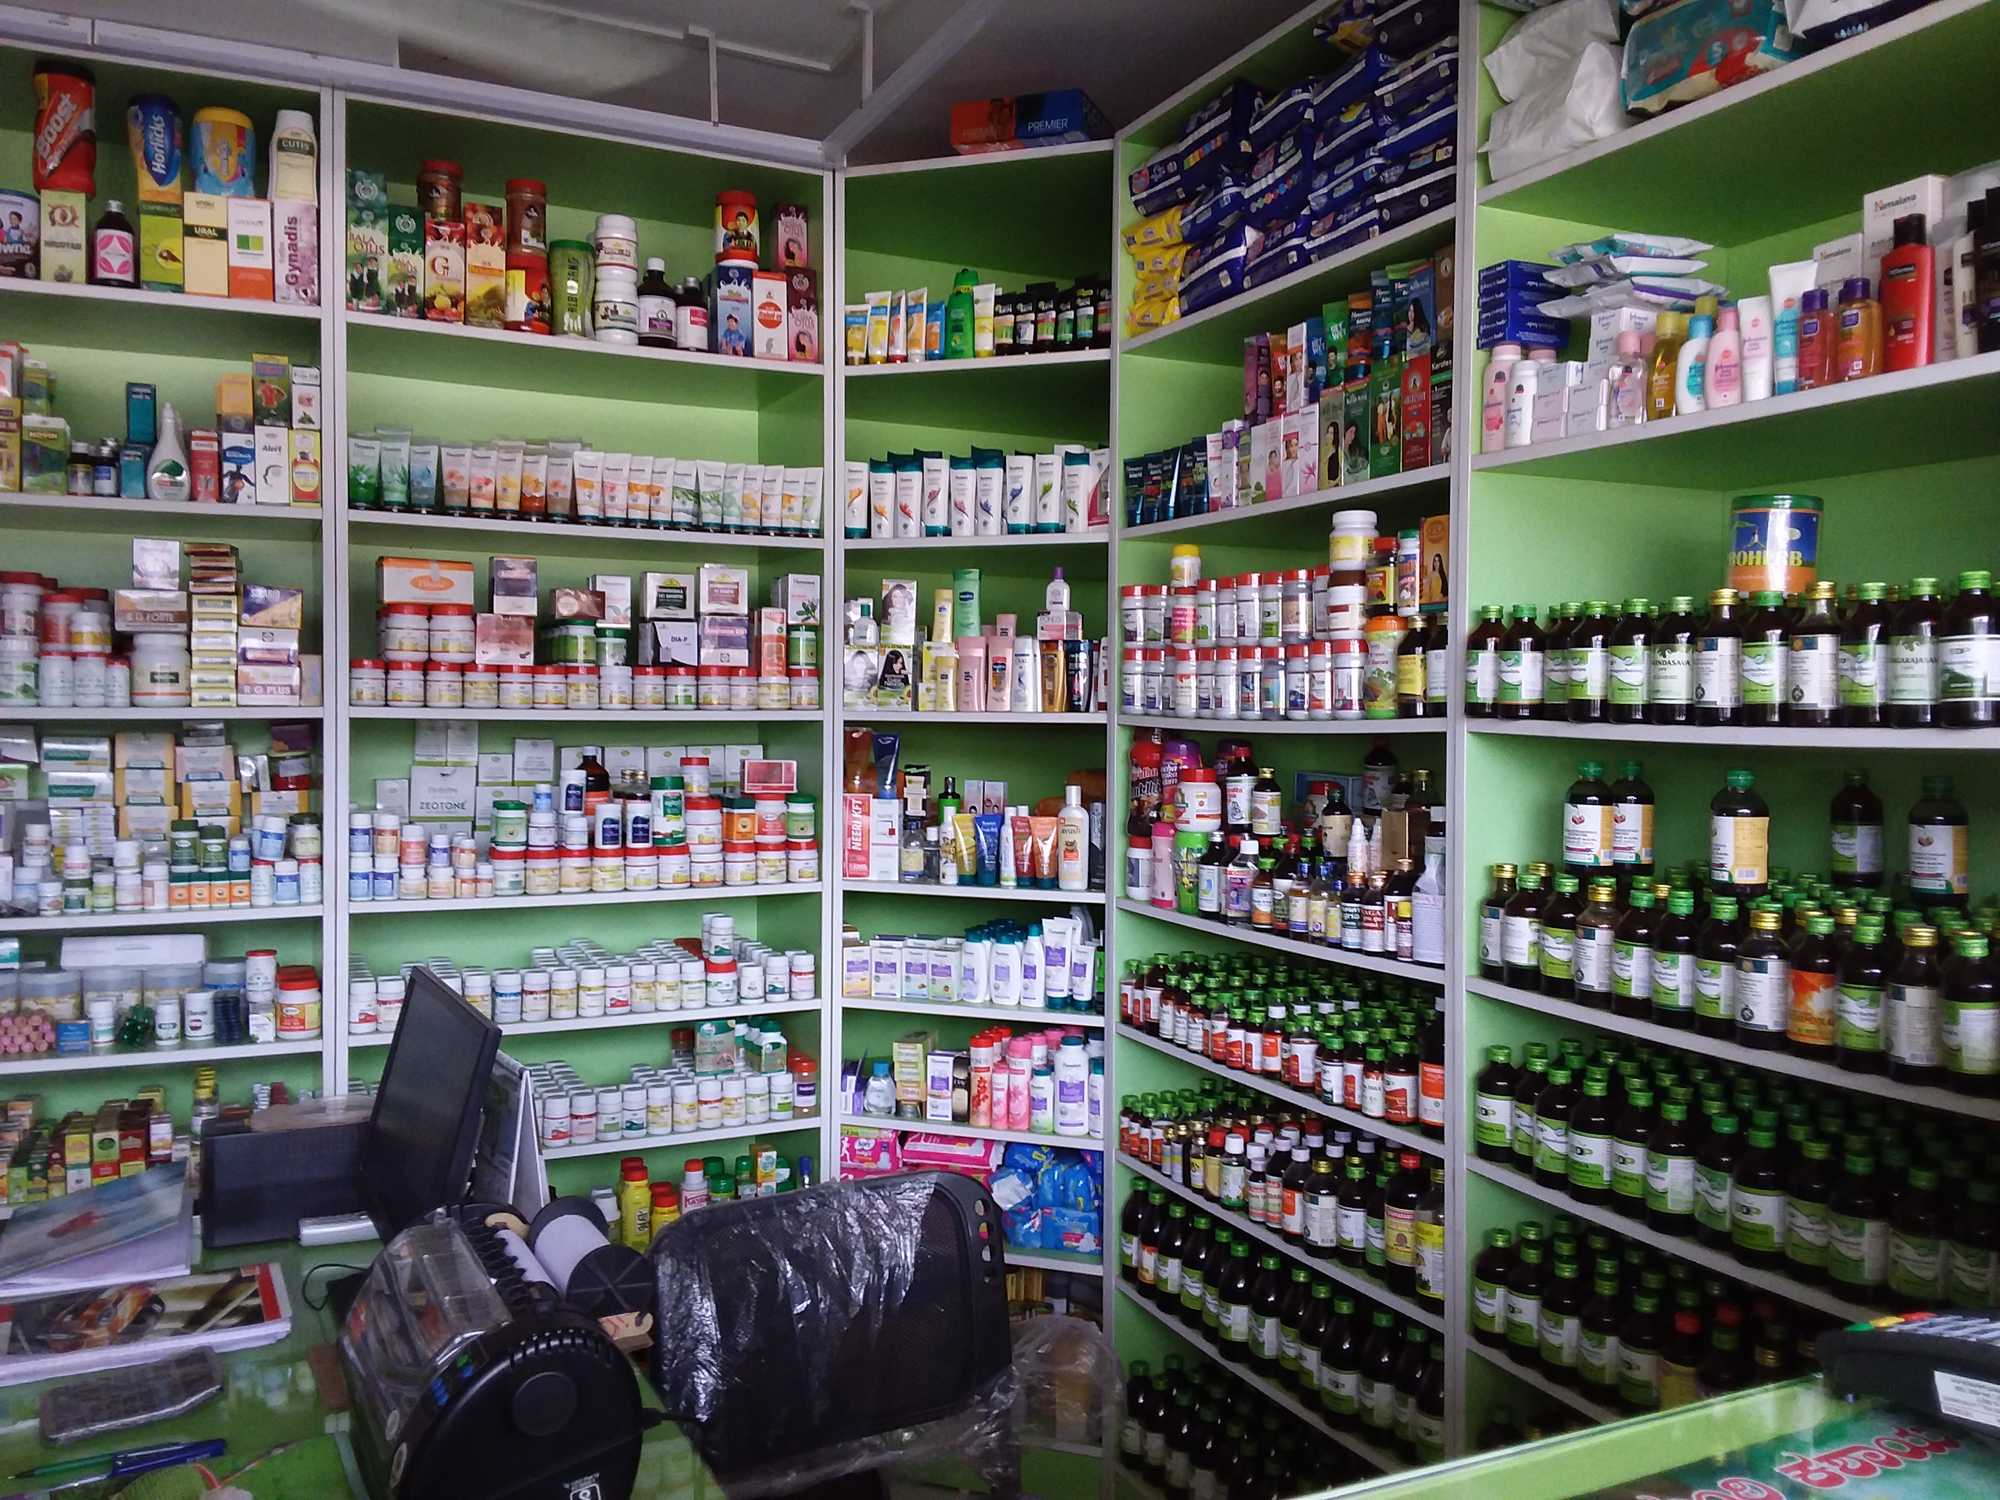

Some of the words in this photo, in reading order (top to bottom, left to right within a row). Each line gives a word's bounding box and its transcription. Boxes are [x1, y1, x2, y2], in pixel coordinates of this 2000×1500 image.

[1027, 118, 1069, 130] PREMIER
[150, 114, 167, 175] Horlicks
[281, 139, 311, 151] CUTIS
[193, 226, 219, 238] URAL
[284, 215, 302, 286] Gynadis
[267, 686, 291, 696] PLUS
[419, 800, 466, 811] ZEOTONE
[851, 820, 863, 851] NEERI
